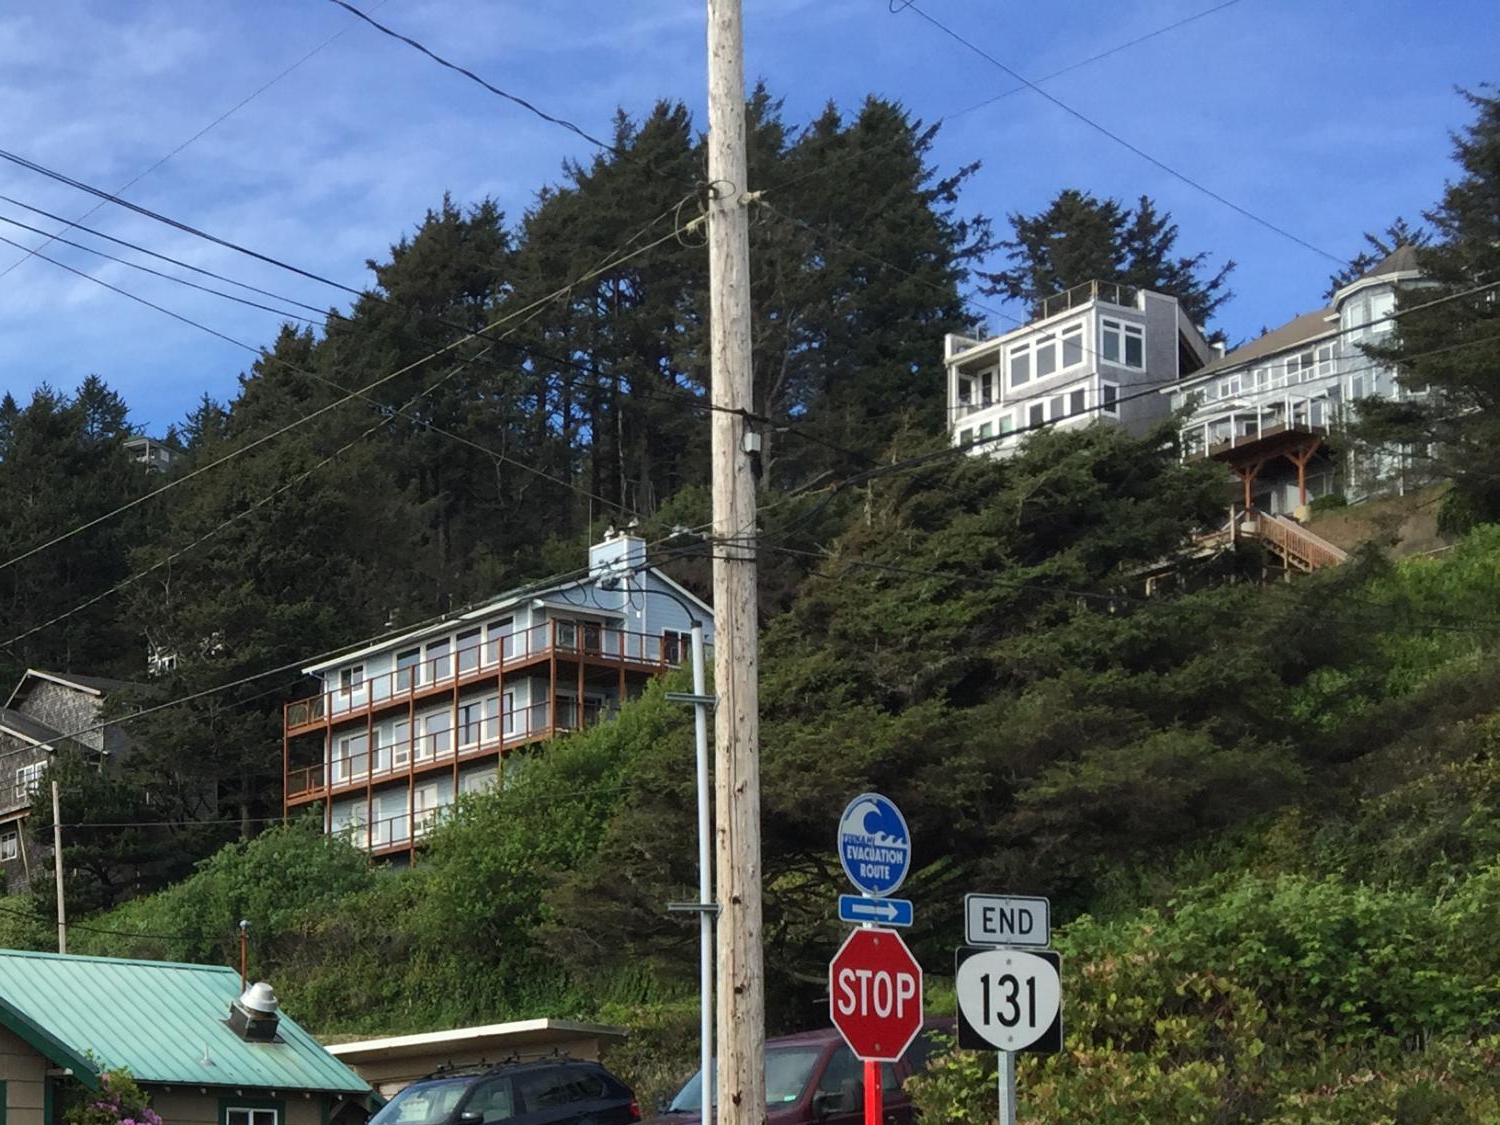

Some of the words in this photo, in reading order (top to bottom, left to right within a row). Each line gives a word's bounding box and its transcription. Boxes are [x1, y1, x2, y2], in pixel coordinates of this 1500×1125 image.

[846, 845, 904, 864] EVACUATION
[860, 863, 891, 880] ROUTE
[982, 906, 1033, 935] END
[838, 968, 915, 1018] STOP
[980, 973, 1036, 1028] 131
